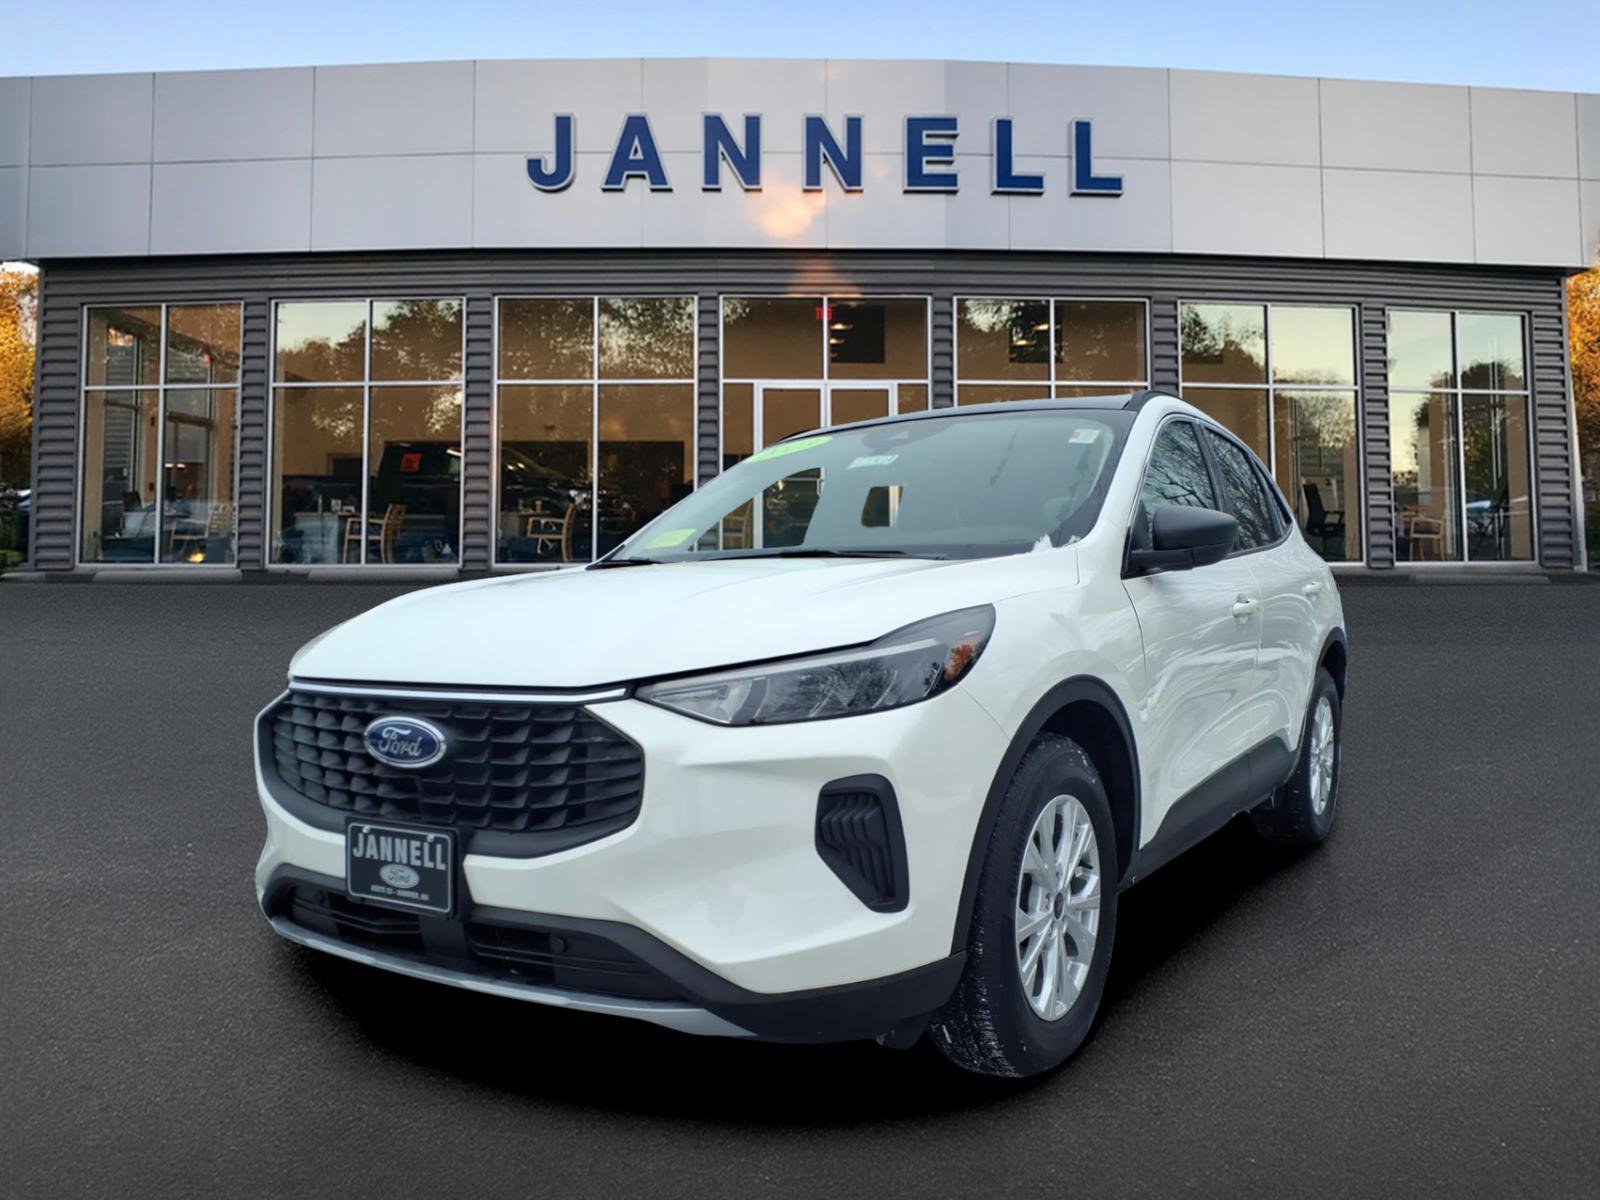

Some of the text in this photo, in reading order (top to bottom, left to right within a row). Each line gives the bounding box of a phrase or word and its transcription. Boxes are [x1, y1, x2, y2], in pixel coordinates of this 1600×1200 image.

[525, 112, 1123, 196] JANNELL
[379, 726, 422, 756] Ford
[352, 833, 447, 871] JANNELL
